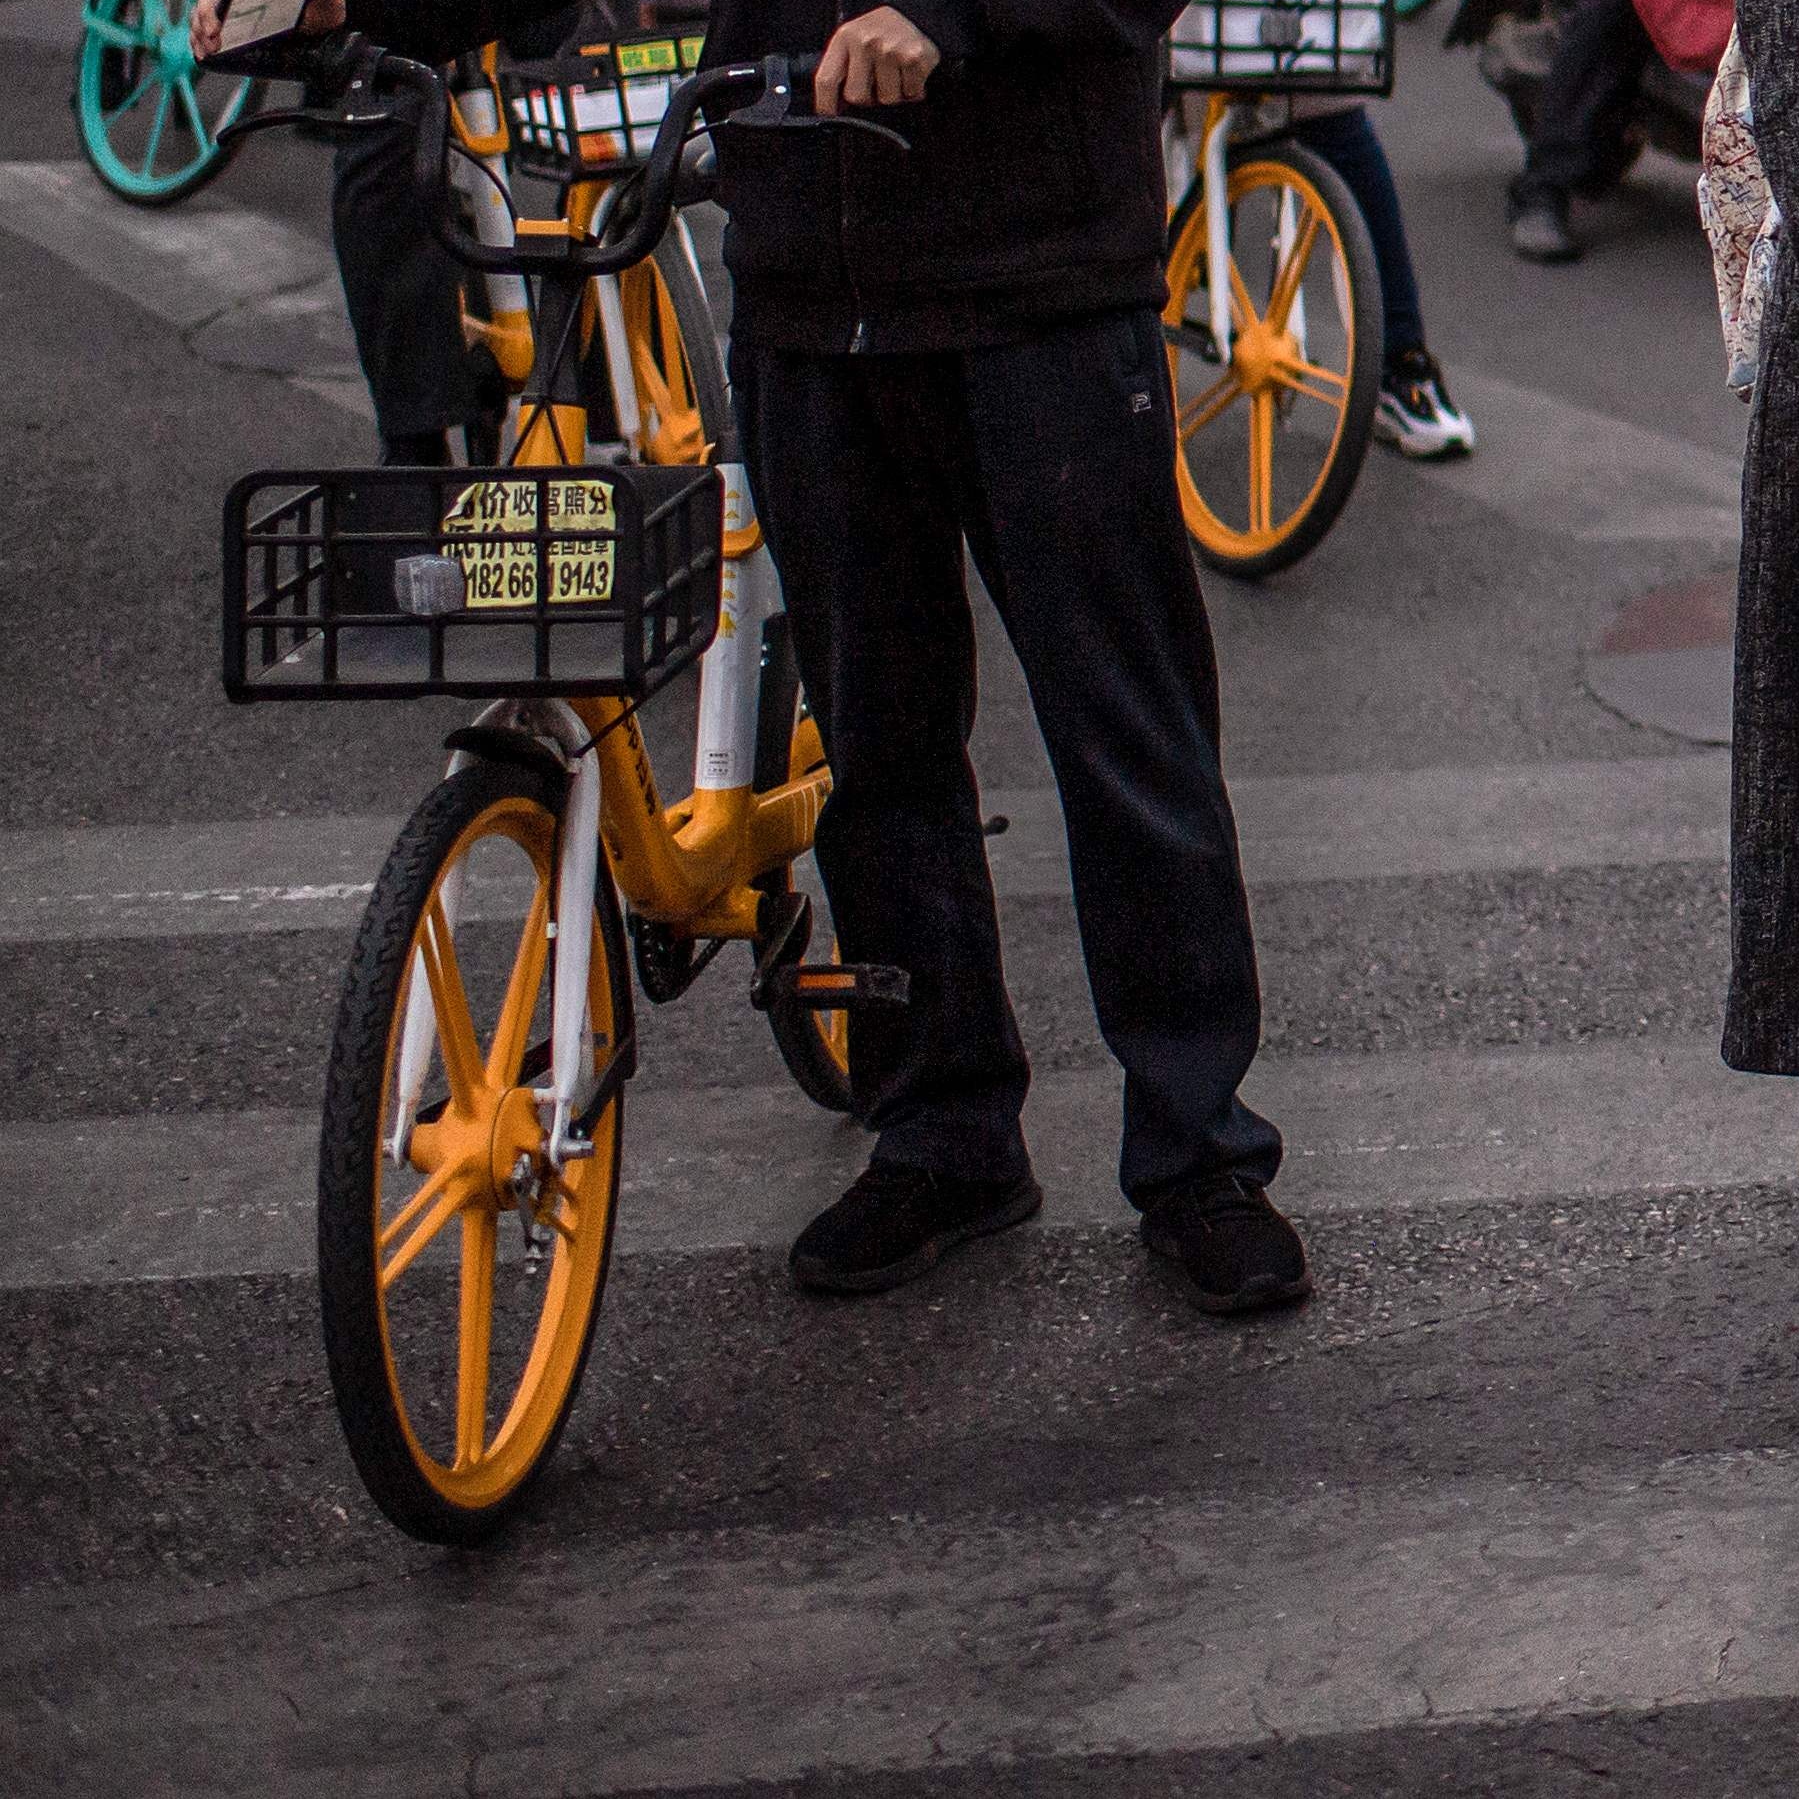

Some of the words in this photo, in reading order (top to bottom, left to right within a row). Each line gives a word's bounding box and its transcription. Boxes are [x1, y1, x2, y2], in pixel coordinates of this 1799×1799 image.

[459, 482, 608, 519] 价收驾照分
[466, 562, 505, 599] 182
[509, 562, 556, 598] 661
[559, 561, 609, 597] 9143
